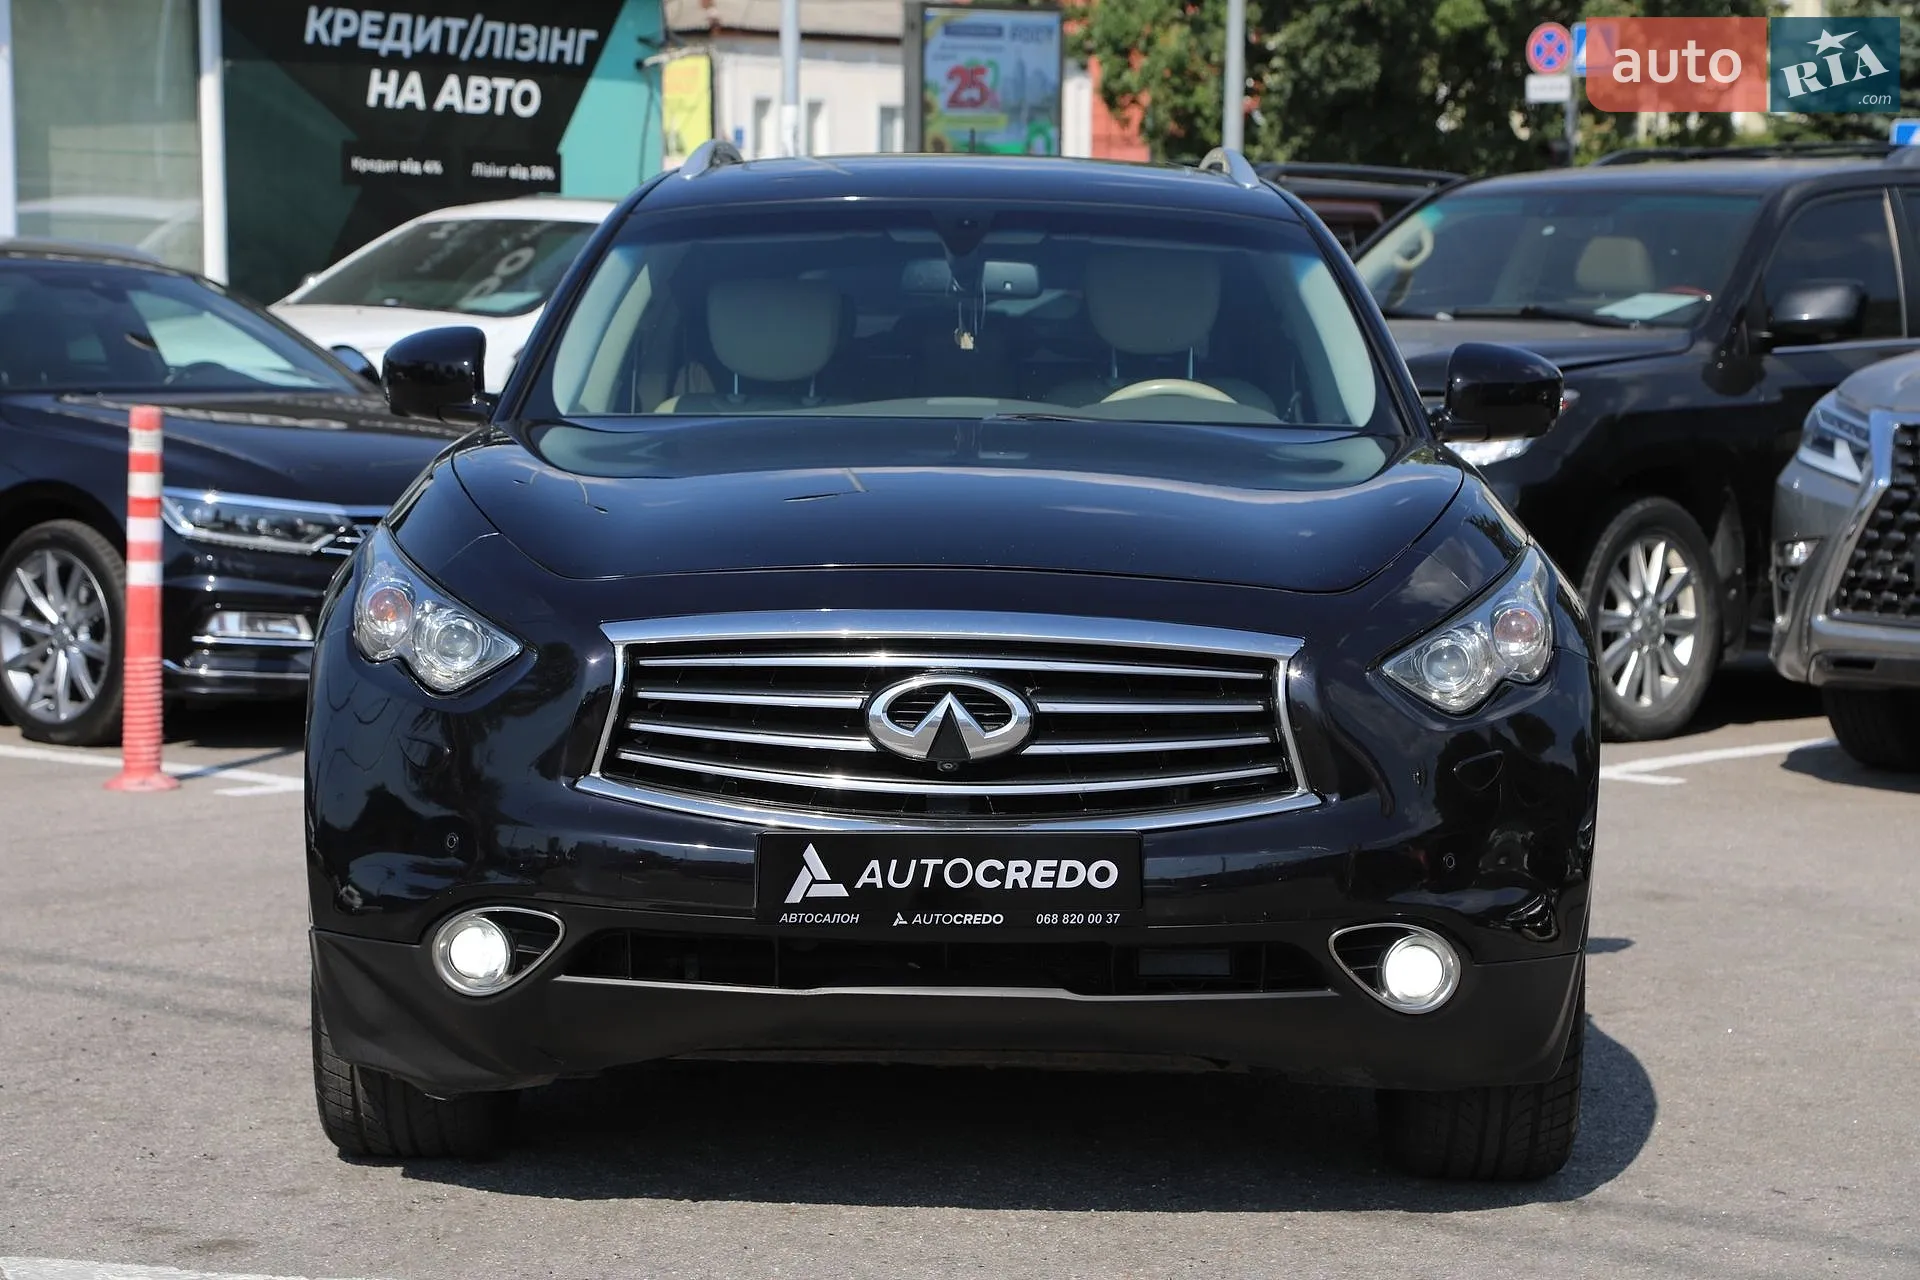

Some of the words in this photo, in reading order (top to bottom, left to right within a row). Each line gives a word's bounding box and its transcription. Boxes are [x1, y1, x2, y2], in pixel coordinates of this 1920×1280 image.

[304, 5, 599, 66] КРЕДИТ/ЛІЗІНГ
[366, 68, 426, 110] НА
[433, 74, 542, 118] АВТО
[947, 65, 990, 108] 25
[854, 857, 1119, 890] AUTOCREDO
[778, 912, 860, 925] АВТОСАЛОН
[911, 913, 1004, 926] AUTOCREDO
[1036, 913, 1059, 925] 068
[1061, 913, 1085, 925] 820
[1087, 913, 1103, 925] 00
[1105, 913, 1121, 925] 37
